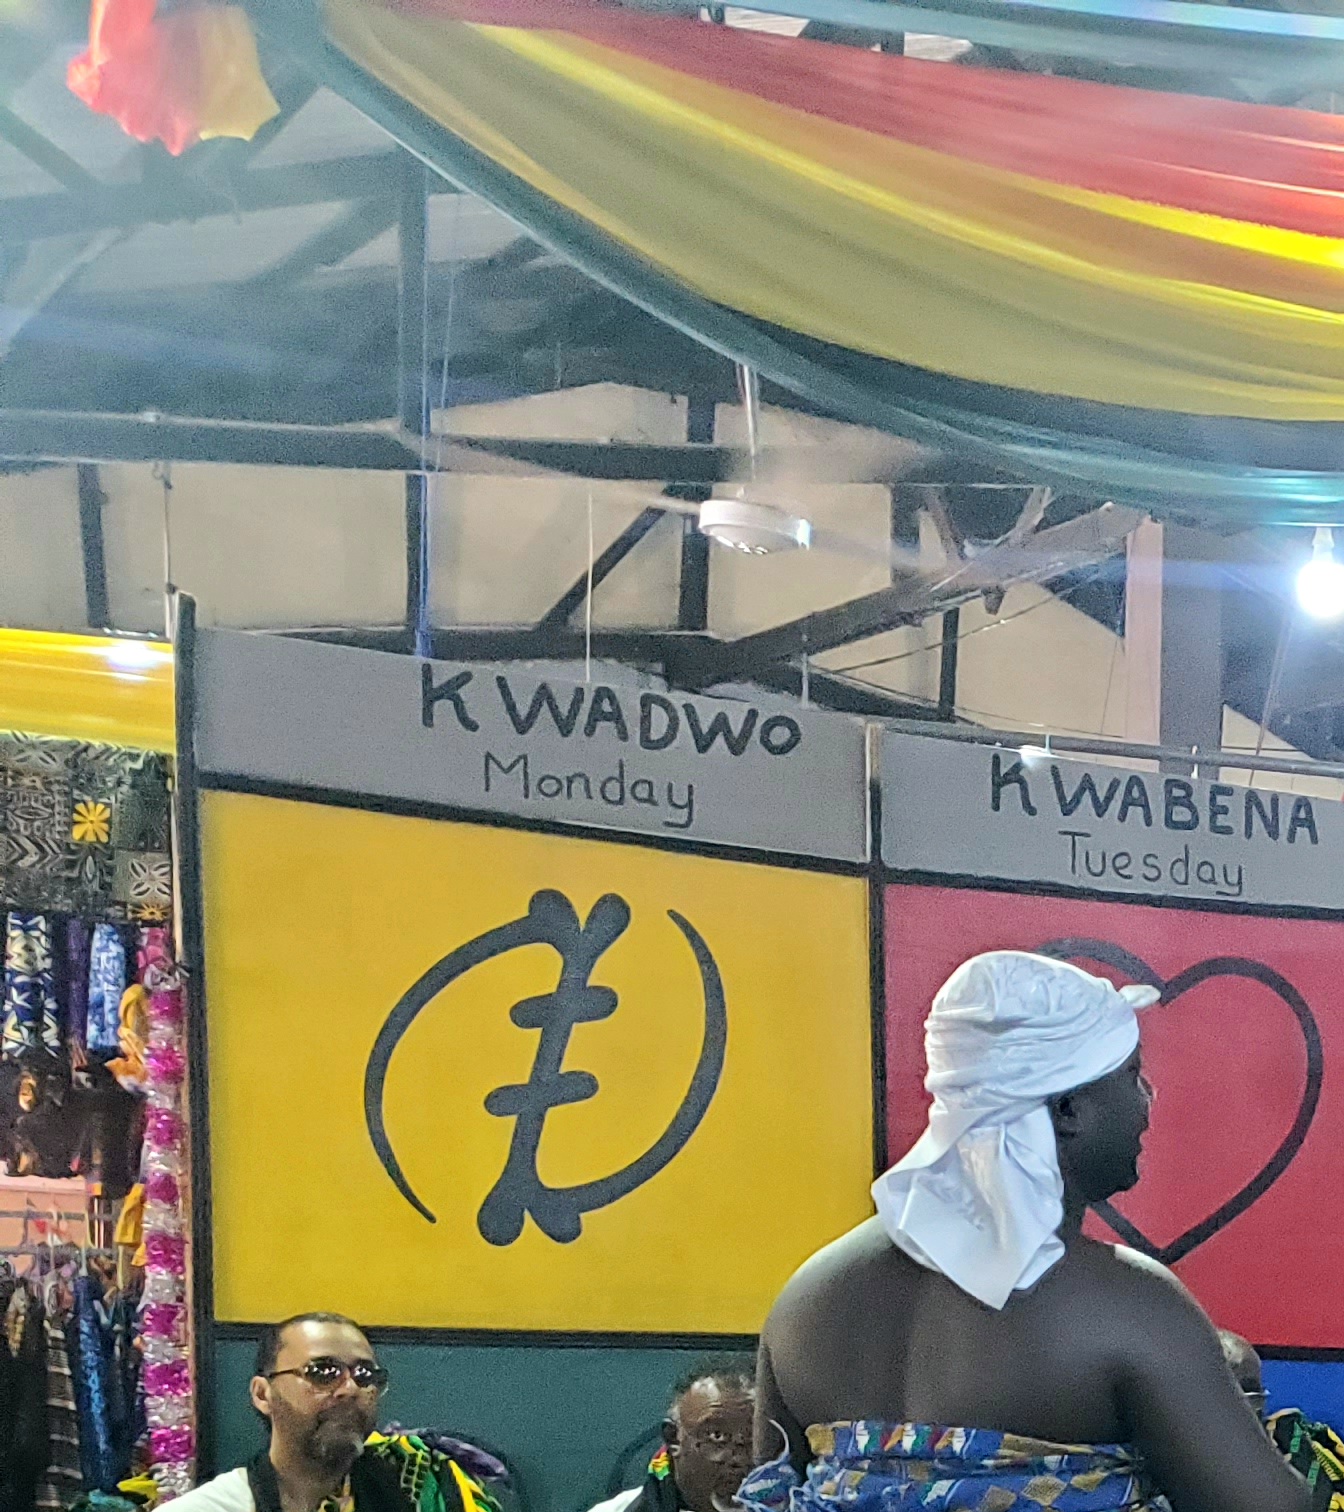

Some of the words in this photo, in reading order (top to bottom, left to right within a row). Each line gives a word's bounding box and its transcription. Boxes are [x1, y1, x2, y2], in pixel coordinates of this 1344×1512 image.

[421, 663, 801, 759] KWADWO
[484, 752, 696, 829] Monday
[990, 751, 1320, 846] KWABENA
[1057, 830, 1245, 897] Tuesday
